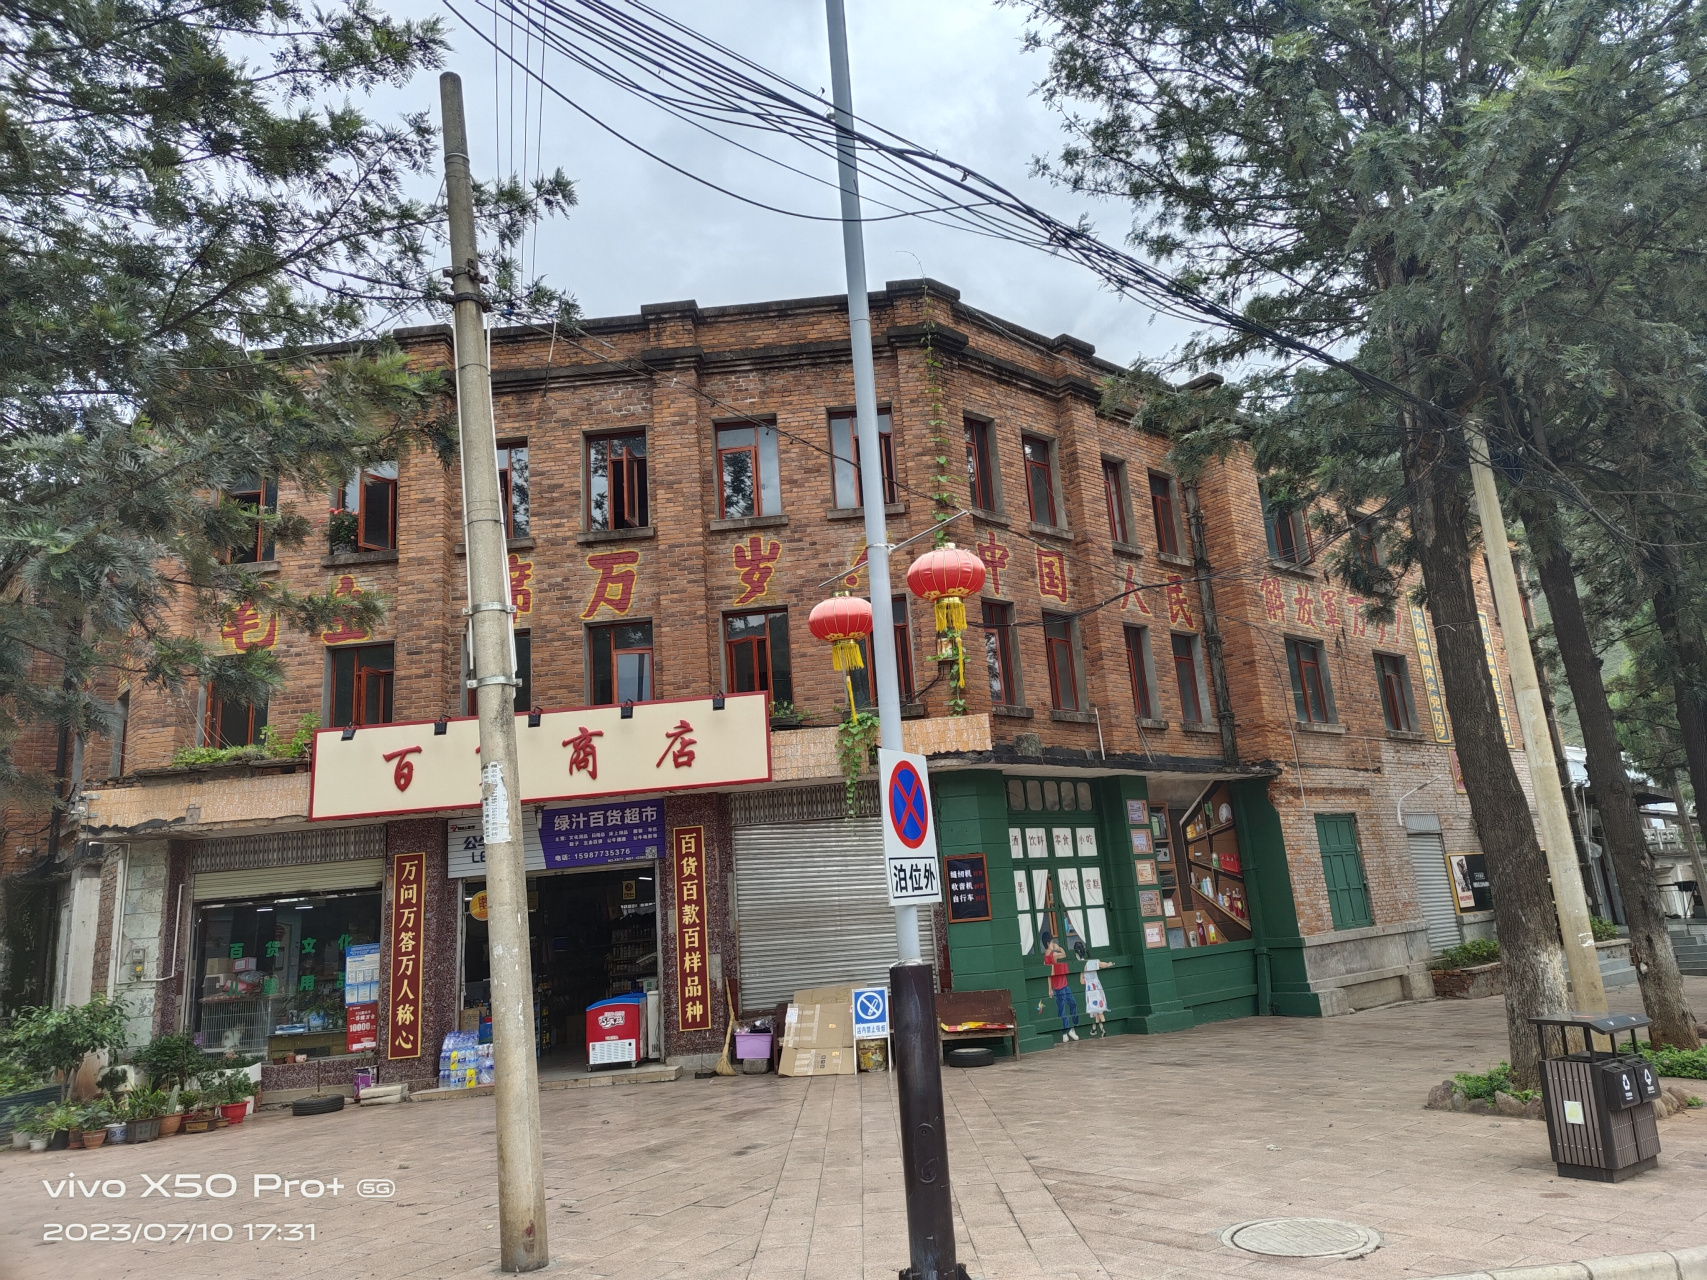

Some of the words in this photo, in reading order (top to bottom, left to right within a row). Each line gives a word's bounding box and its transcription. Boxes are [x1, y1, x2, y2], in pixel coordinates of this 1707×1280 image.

[383, 719, 698, 793] 百商店
[554, 806, 658, 832] 绿汁百货超市
[1028, 835, 1044, 846] 饮料
[1054, 834, 1069, 846] 零食
[1079, 834, 1094, 845] 小吃
[574, 848, 631, 860] 15987735376
[893, 863, 936, 893] 泊位外
[951, 882, 973, 891] 收音机
[1062, 879, 1077, 891] 冷饮
[1085, 879, 1100, 890] 雪糕
[953, 893, 975, 903] 自行车
[680, 833, 703, 1023] 百货百款百样品种
[395, 860, 418, 1050] 万问万答万人称心
[349, 1022, 371, 1032] 10000
[857, 1024, 885, 1034] 店内禁止吸烟
